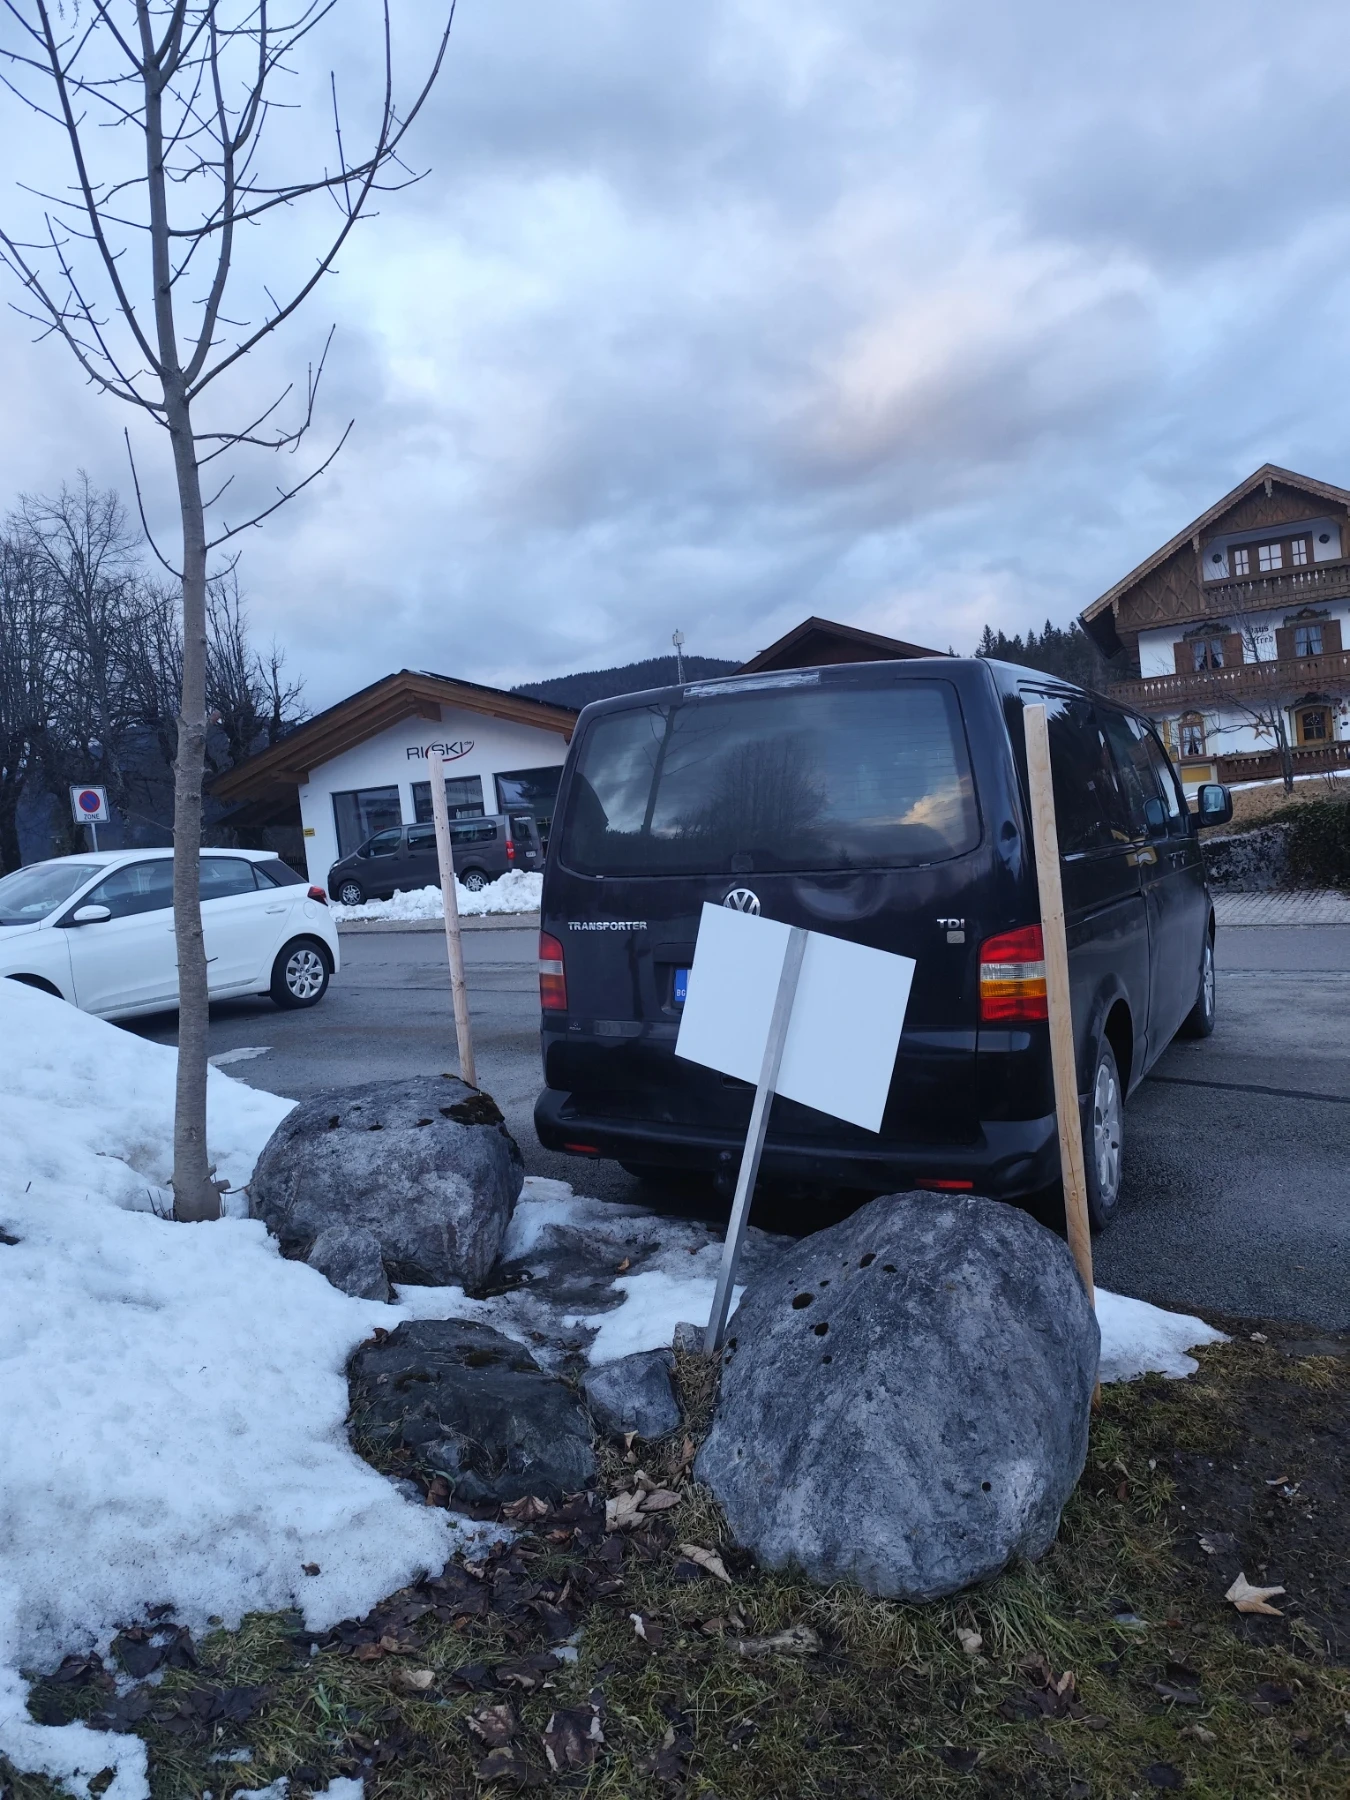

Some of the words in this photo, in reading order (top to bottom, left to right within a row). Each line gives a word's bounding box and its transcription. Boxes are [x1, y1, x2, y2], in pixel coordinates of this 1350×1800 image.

[1246, 634, 1274, 646] Afred
[567, 921, 648, 931] TRANSPORTER
[936, 918, 965, 929] TDI
